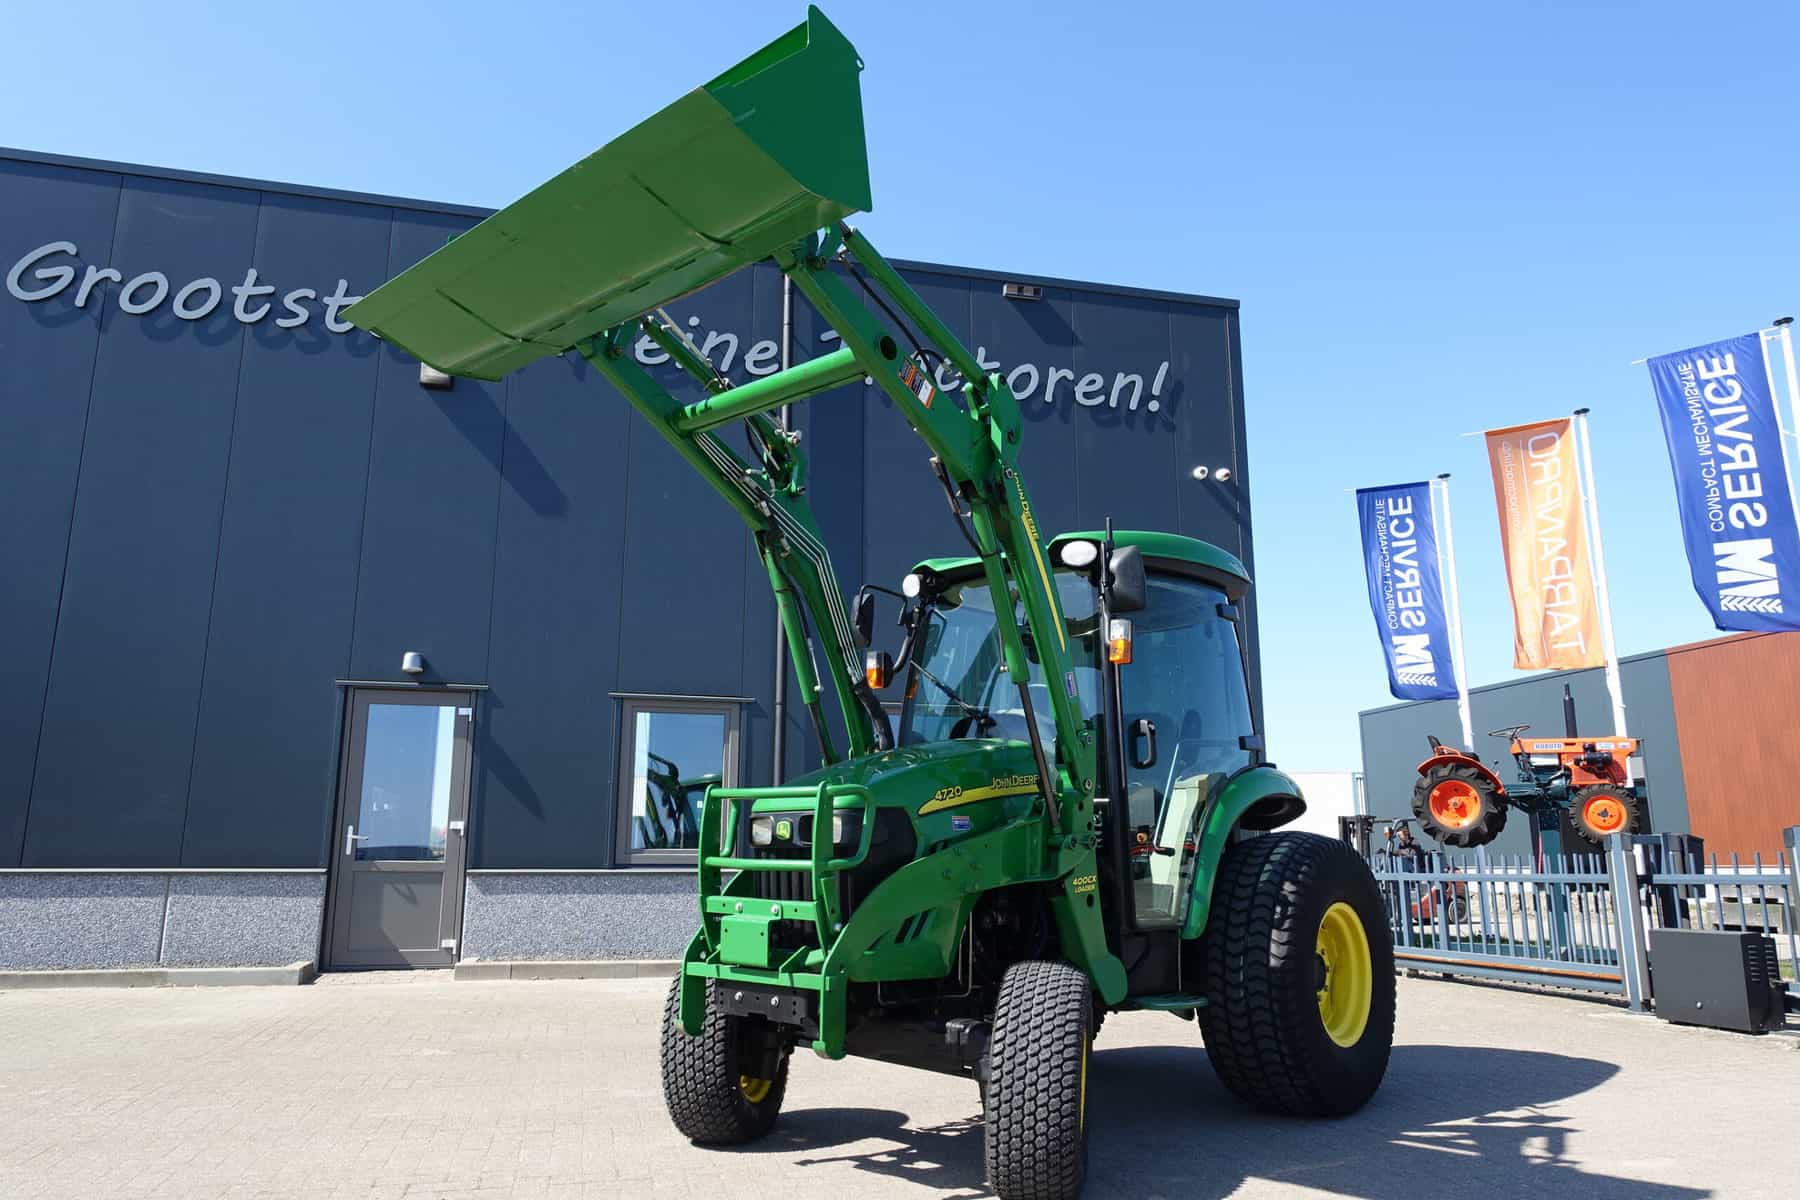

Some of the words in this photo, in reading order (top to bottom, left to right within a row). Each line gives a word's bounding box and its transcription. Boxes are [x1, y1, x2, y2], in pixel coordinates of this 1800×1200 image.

[6, 240, 363, 333] Grootst
[992, 776, 1011, 789] JOHN
[935, 785, 962, 801] 4720
